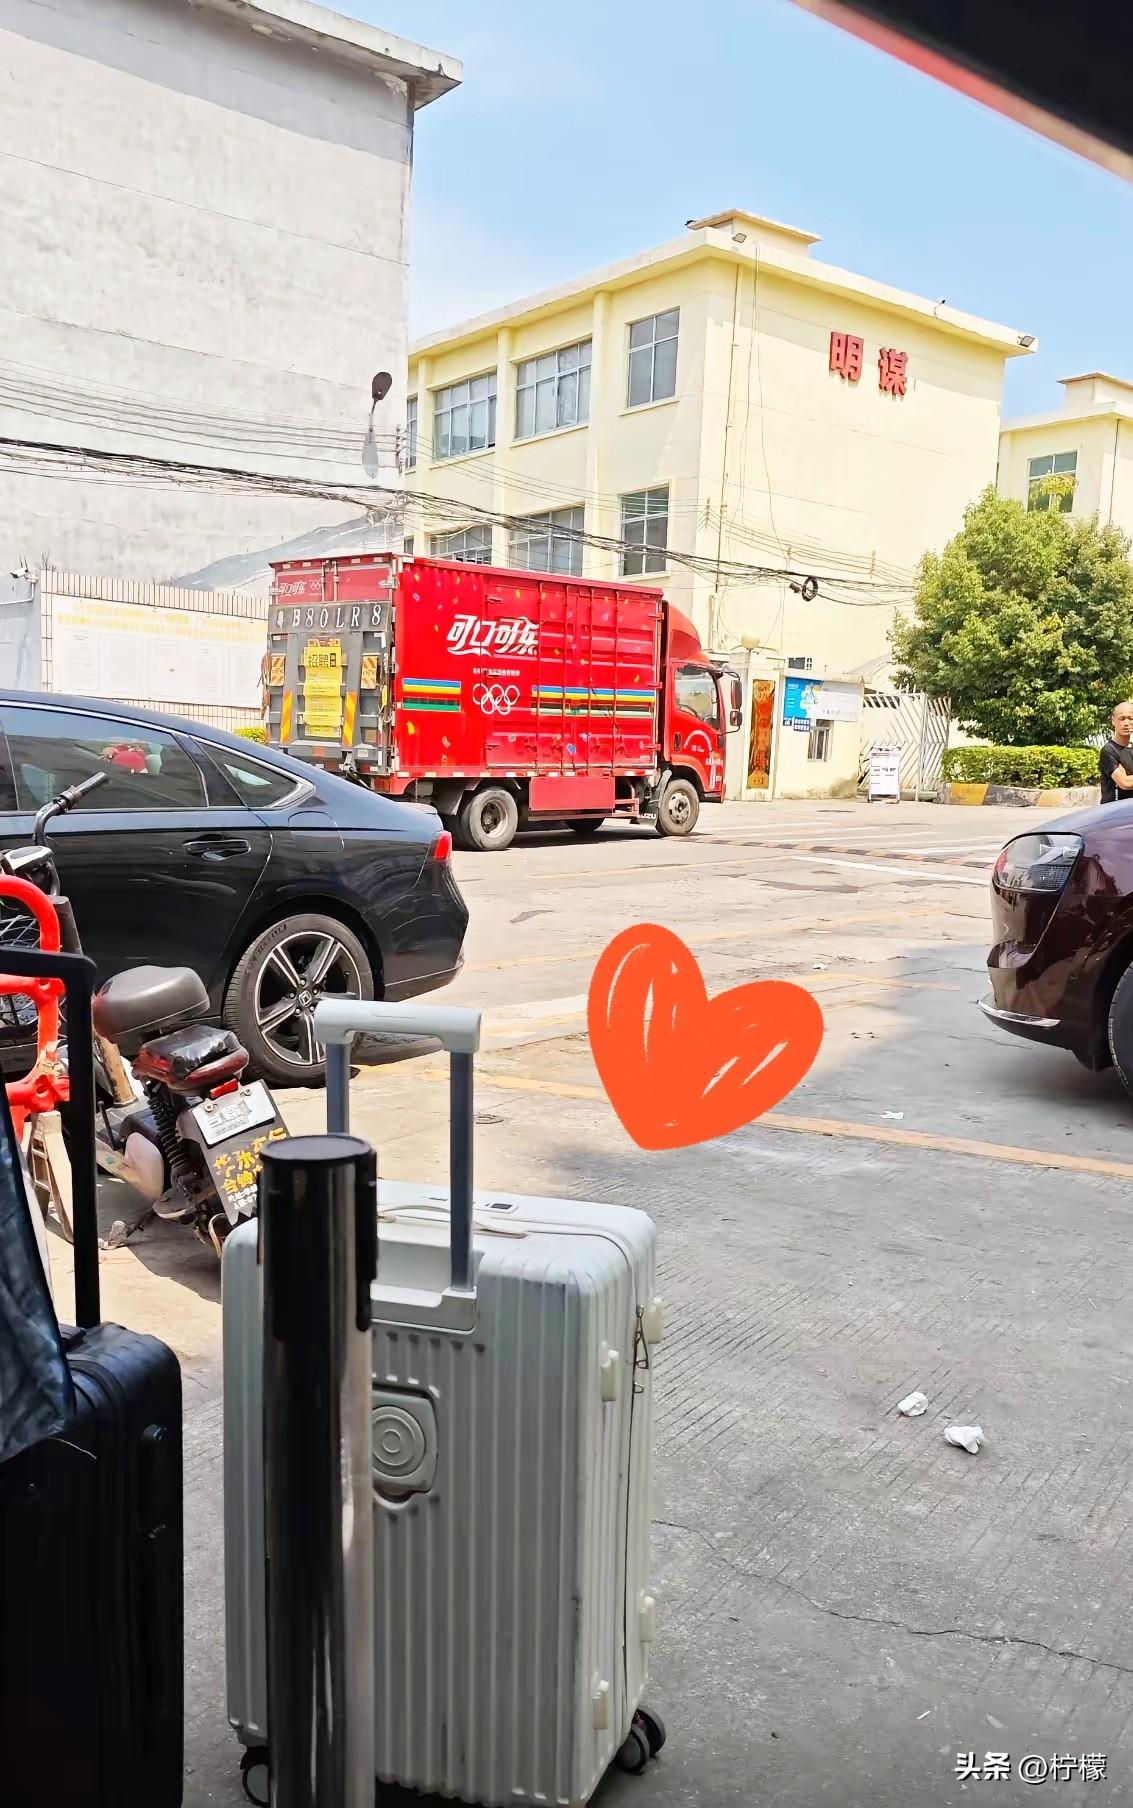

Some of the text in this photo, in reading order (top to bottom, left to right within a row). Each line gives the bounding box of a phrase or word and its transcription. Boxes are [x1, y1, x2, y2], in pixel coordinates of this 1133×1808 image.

[829, 332, 908, 395] 明谋
[446, 613, 540, 657] 可口可乐
